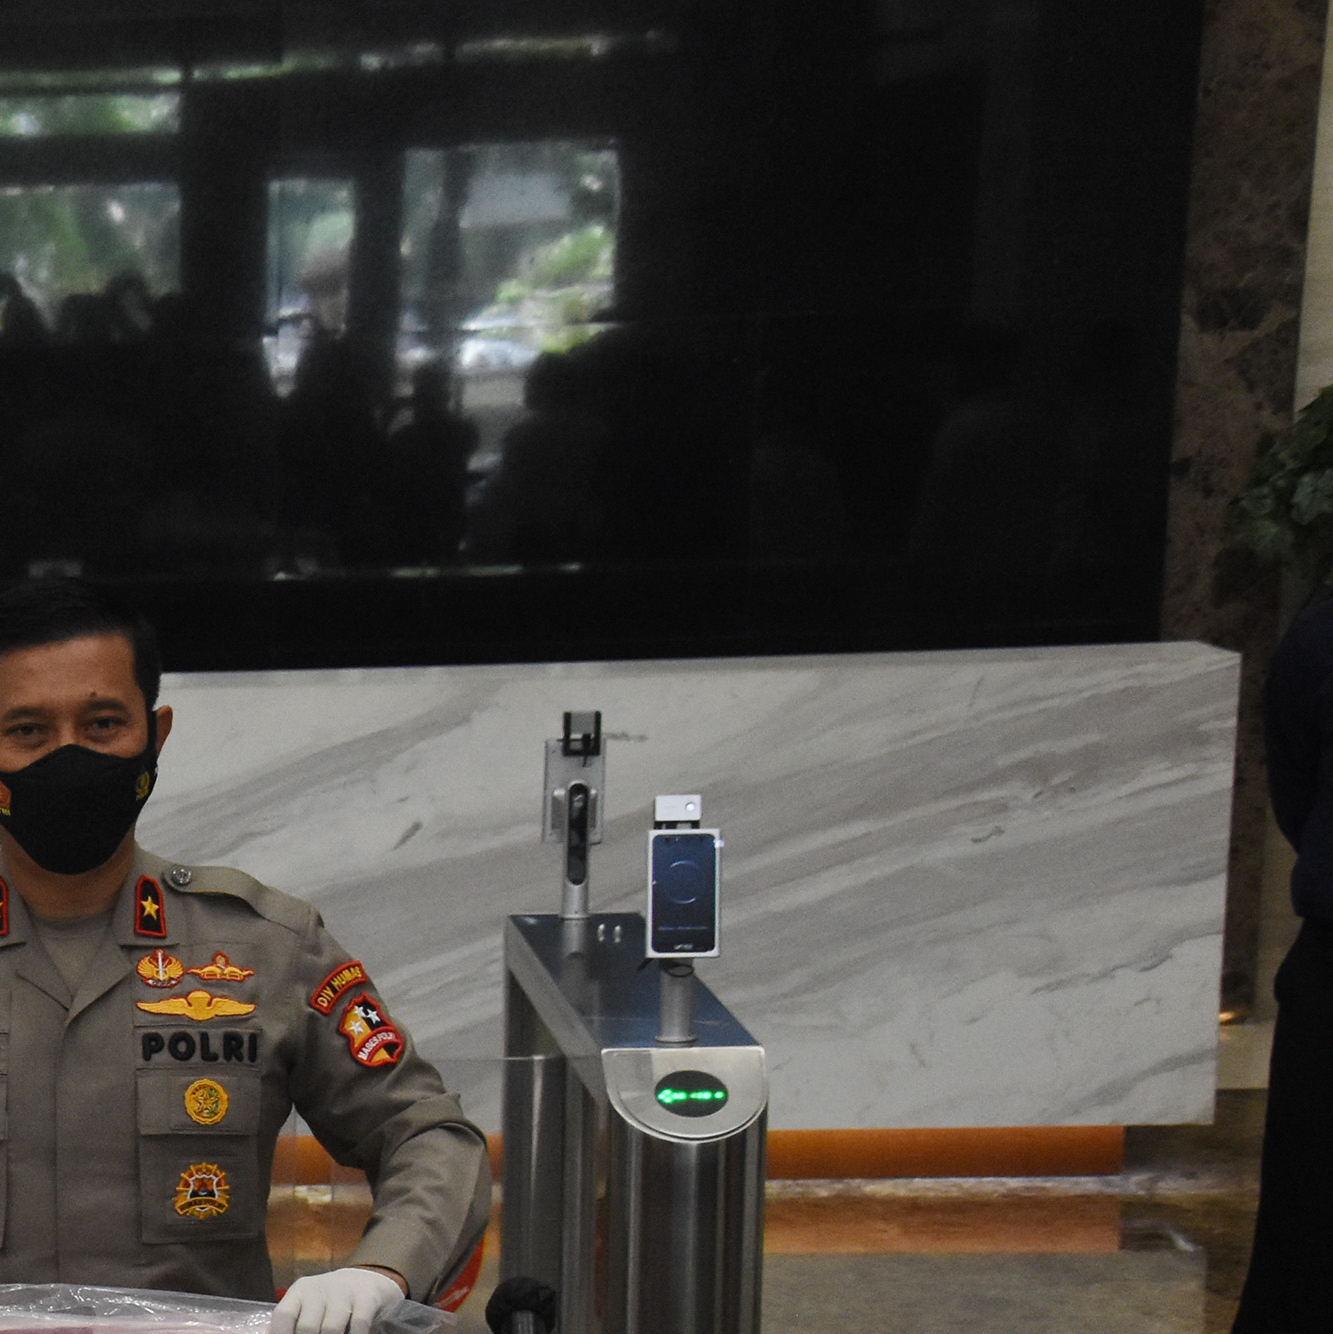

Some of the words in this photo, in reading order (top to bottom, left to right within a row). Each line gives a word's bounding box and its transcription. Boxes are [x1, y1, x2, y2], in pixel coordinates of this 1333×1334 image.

[317, 986, 334, 1007] DIV
[330, 966, 362, 989] HUMAS
[142, 1031, 258, 1062] POLRI
